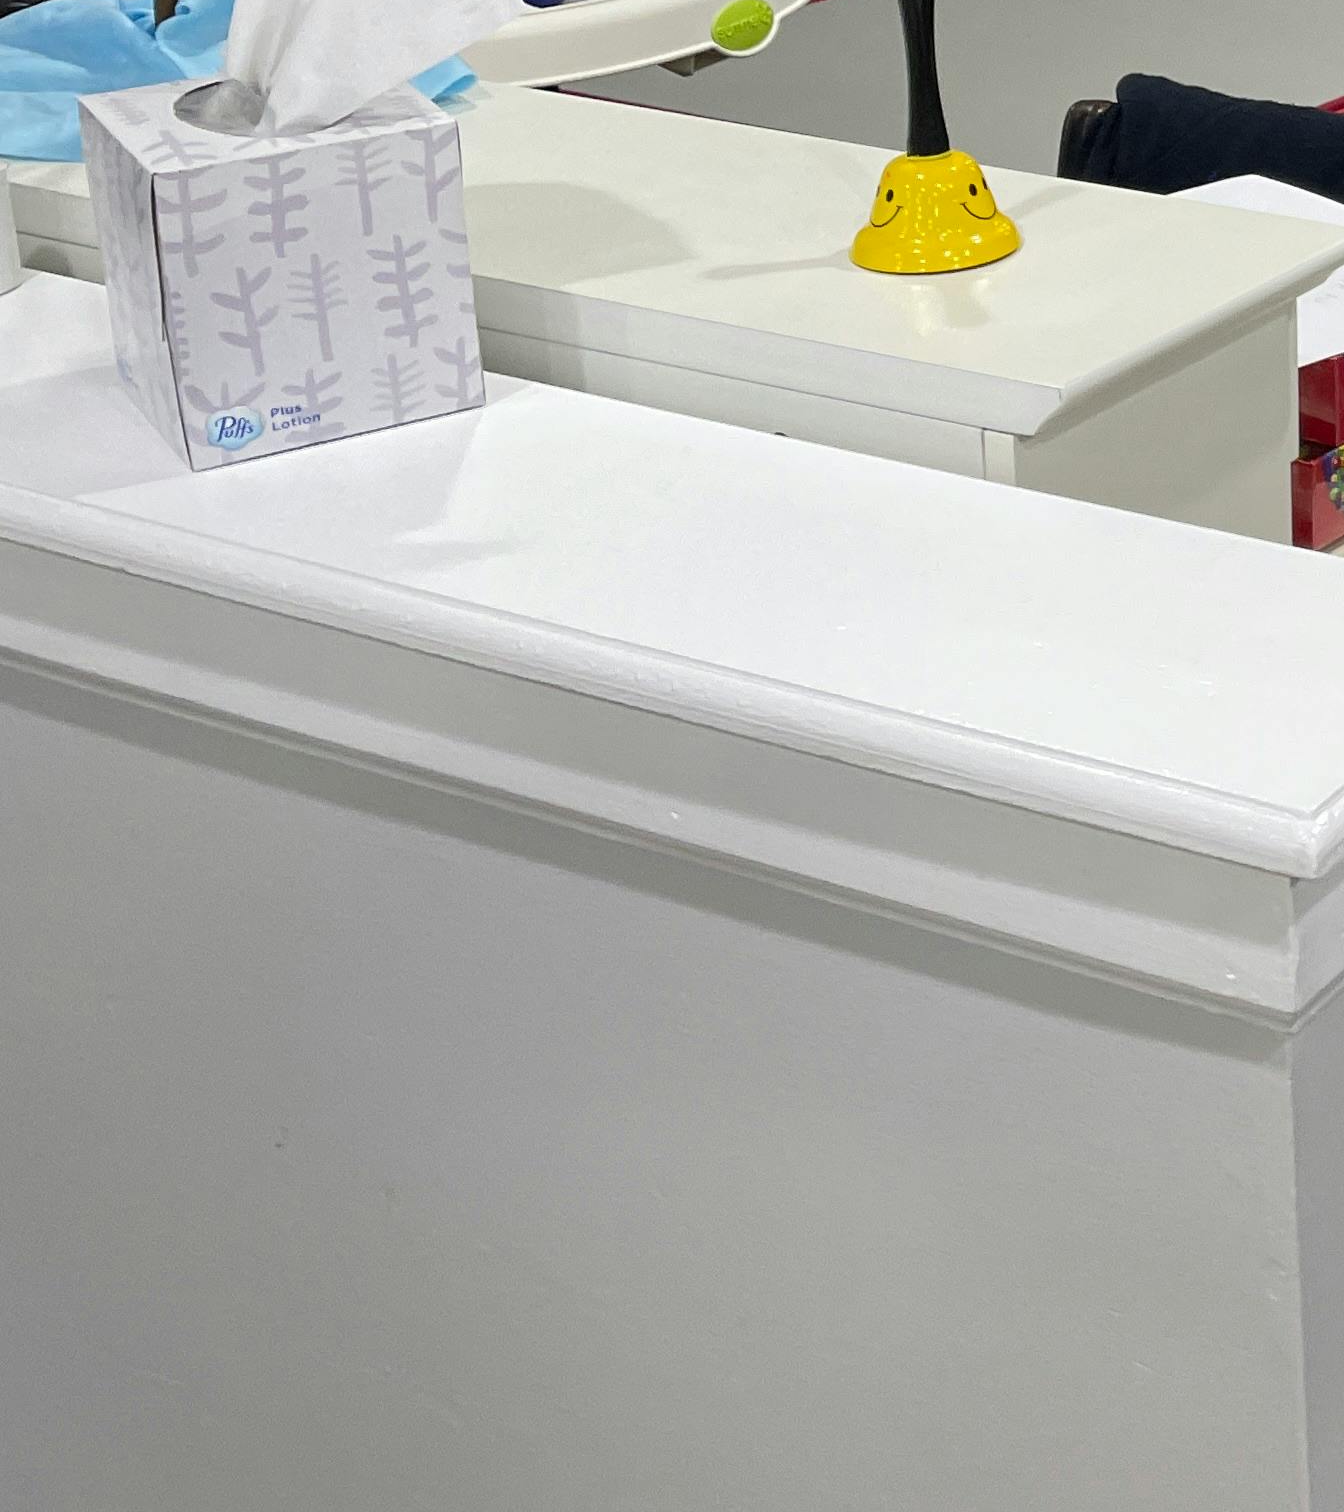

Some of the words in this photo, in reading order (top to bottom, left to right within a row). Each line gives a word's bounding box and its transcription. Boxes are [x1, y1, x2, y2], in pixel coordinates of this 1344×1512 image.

[270, 405, 303, 418] Plus
[214, 415, 254, 442] Puffs
[272, 414, 321, 431] Lotion
